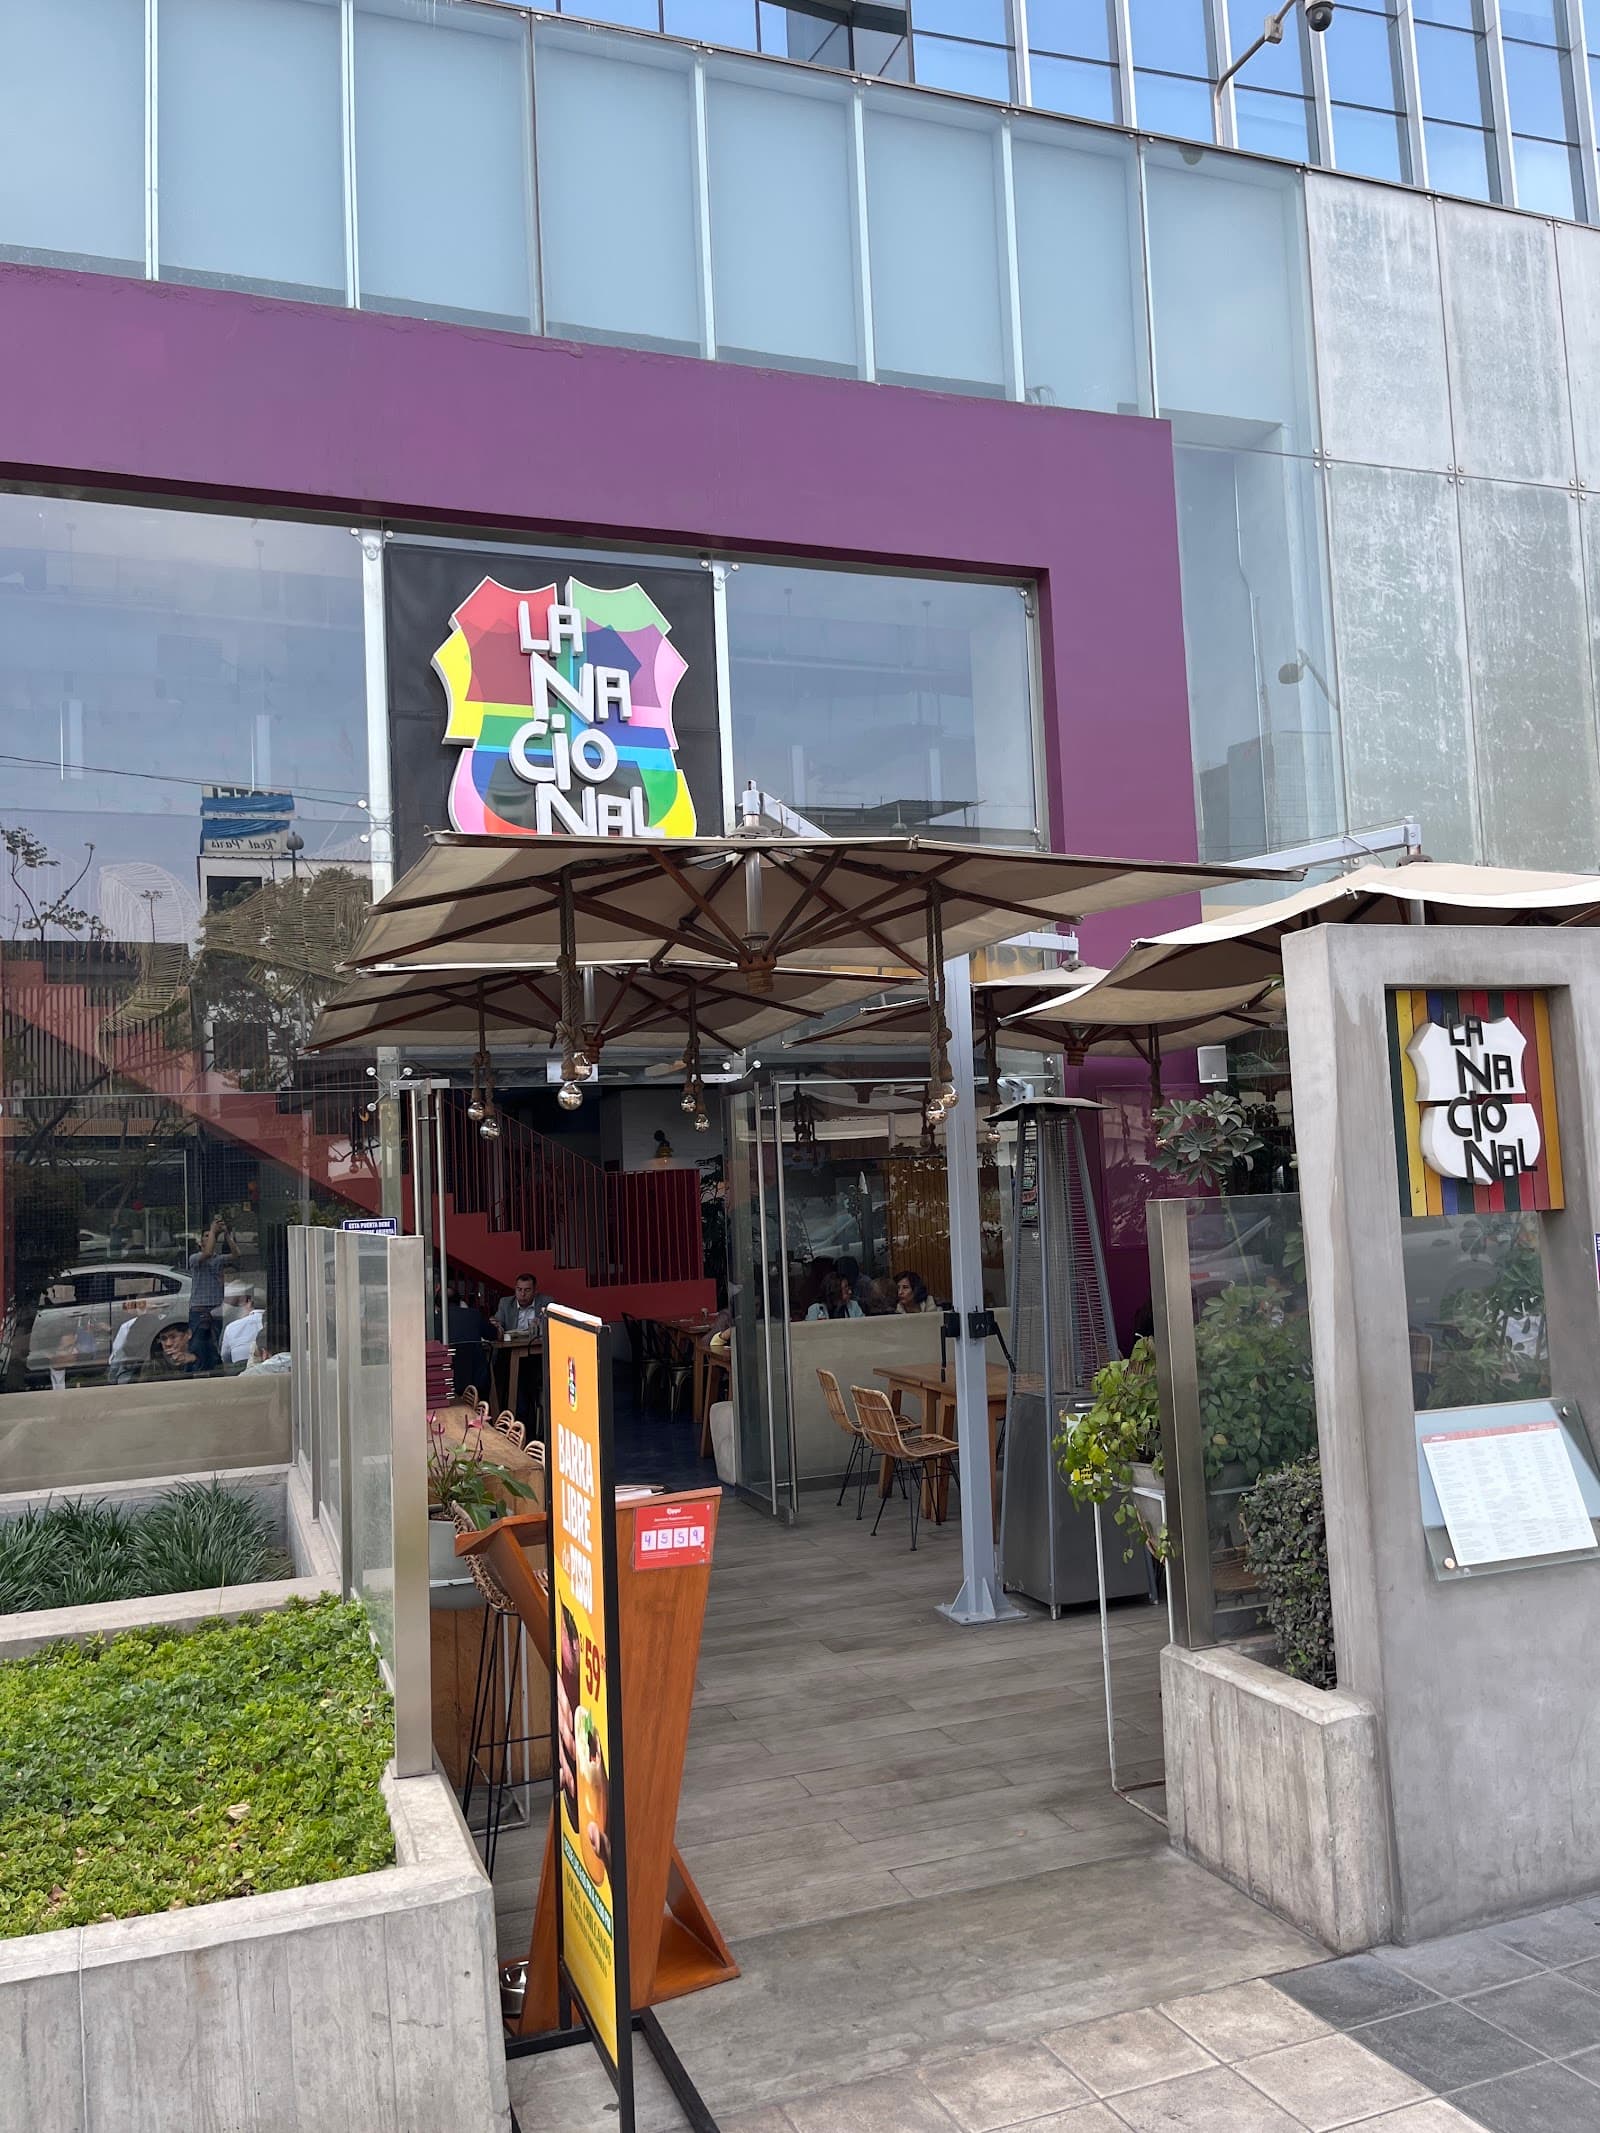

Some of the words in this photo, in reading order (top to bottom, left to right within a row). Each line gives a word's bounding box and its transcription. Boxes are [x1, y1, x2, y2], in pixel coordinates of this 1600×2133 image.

[517, 600, 583, 657] LA
[530, 651, 632, 725] NA
[535, 782, 665, 836] NAL
[1448, 1014, 1483, 1047] LA
[1455, 1048, 1514, 1094] NA
[1463, 1138, 1538, 1184] NAL
[557, 1423, 594, 1497] BARRA
[561, 1479, 592, 1554] LIBRE
[562, 1540, 570, 1574] de
[569, 1543, 593, 1615] PISCO
[585, 1636, 600, 1703] 59
